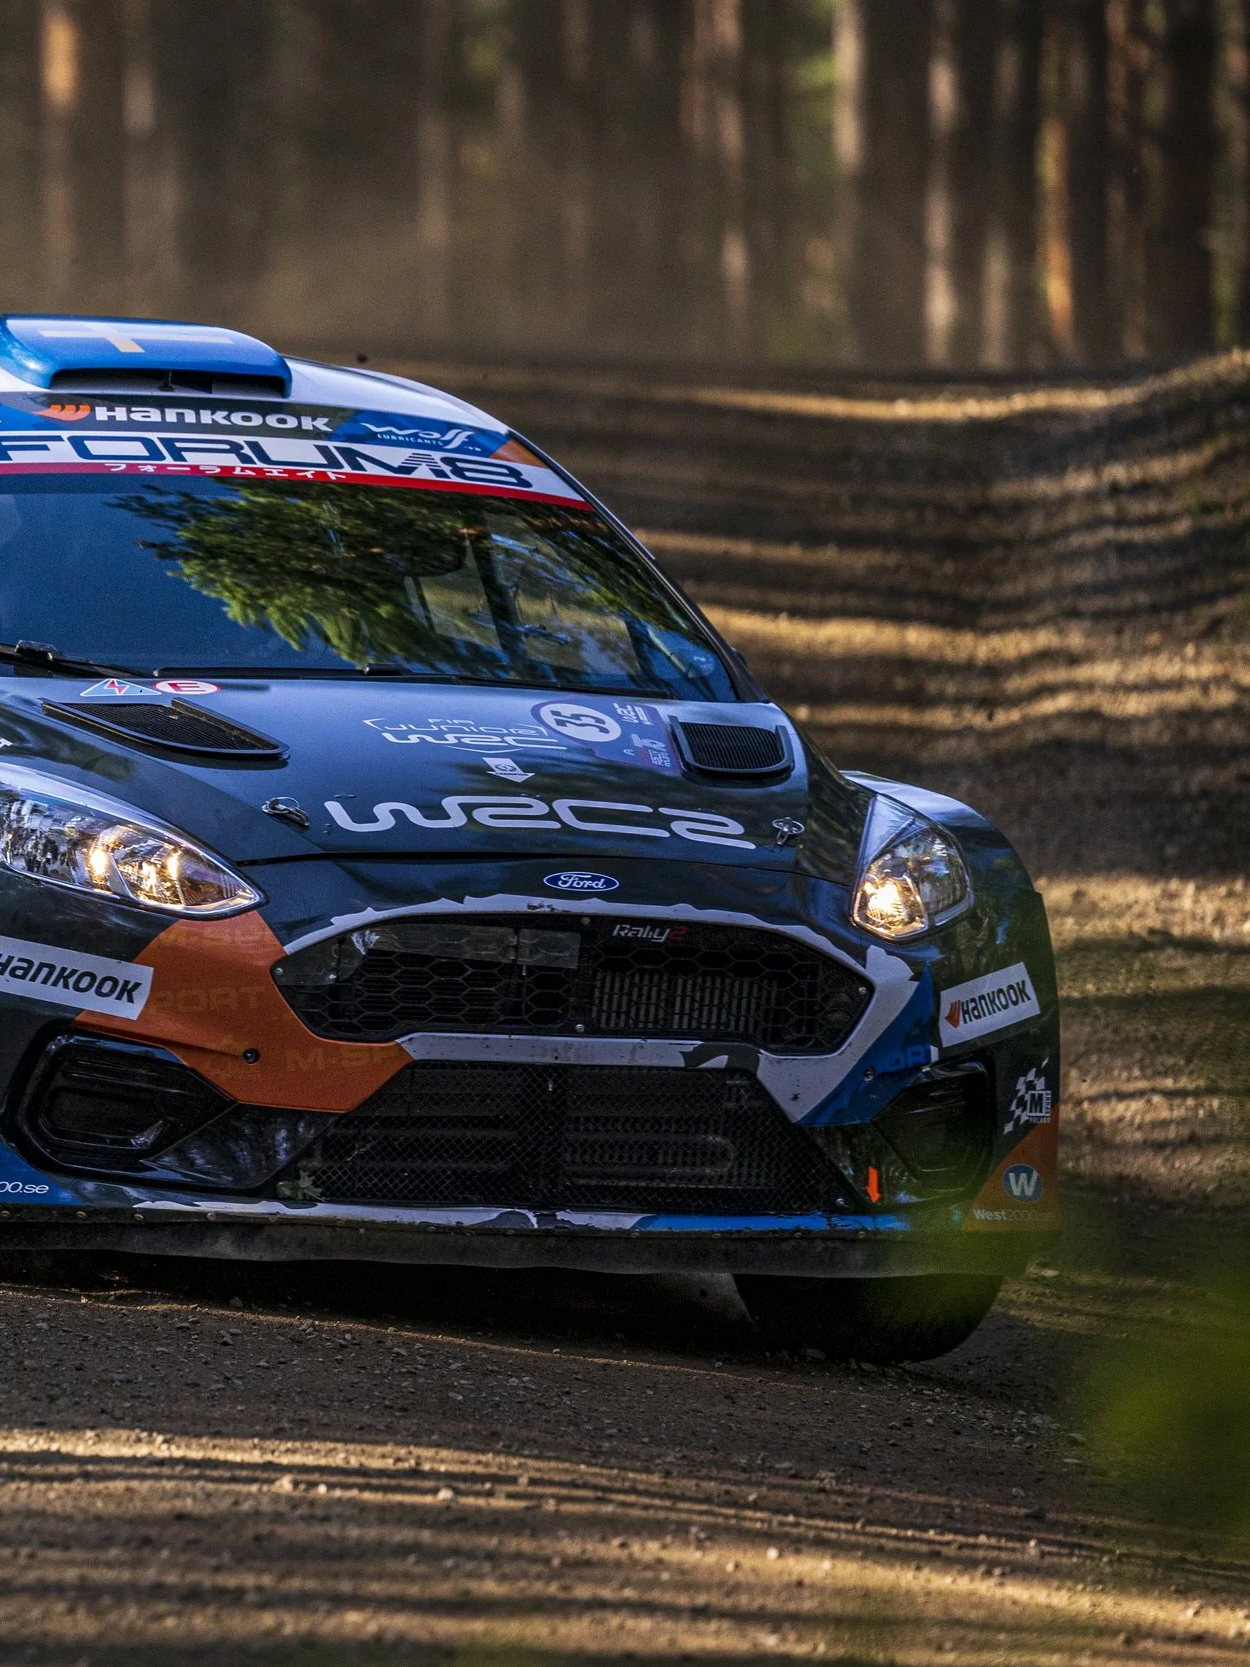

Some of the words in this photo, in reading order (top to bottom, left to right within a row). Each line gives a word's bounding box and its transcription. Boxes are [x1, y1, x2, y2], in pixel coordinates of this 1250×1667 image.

[377, 433, 445, 447] LUBRICANTS
[104, 463, 346, 480] フォーラムエイト
[384, 723, 540, 736] JUNIOR
[381, 732, 568, 751] WRC
[324, 795, 757, 850] WRC2
[558, 873, 607, 890] Ford
[611, 924, 688, 943] Rally2
[1008, 1172, 1039, 1196] W
